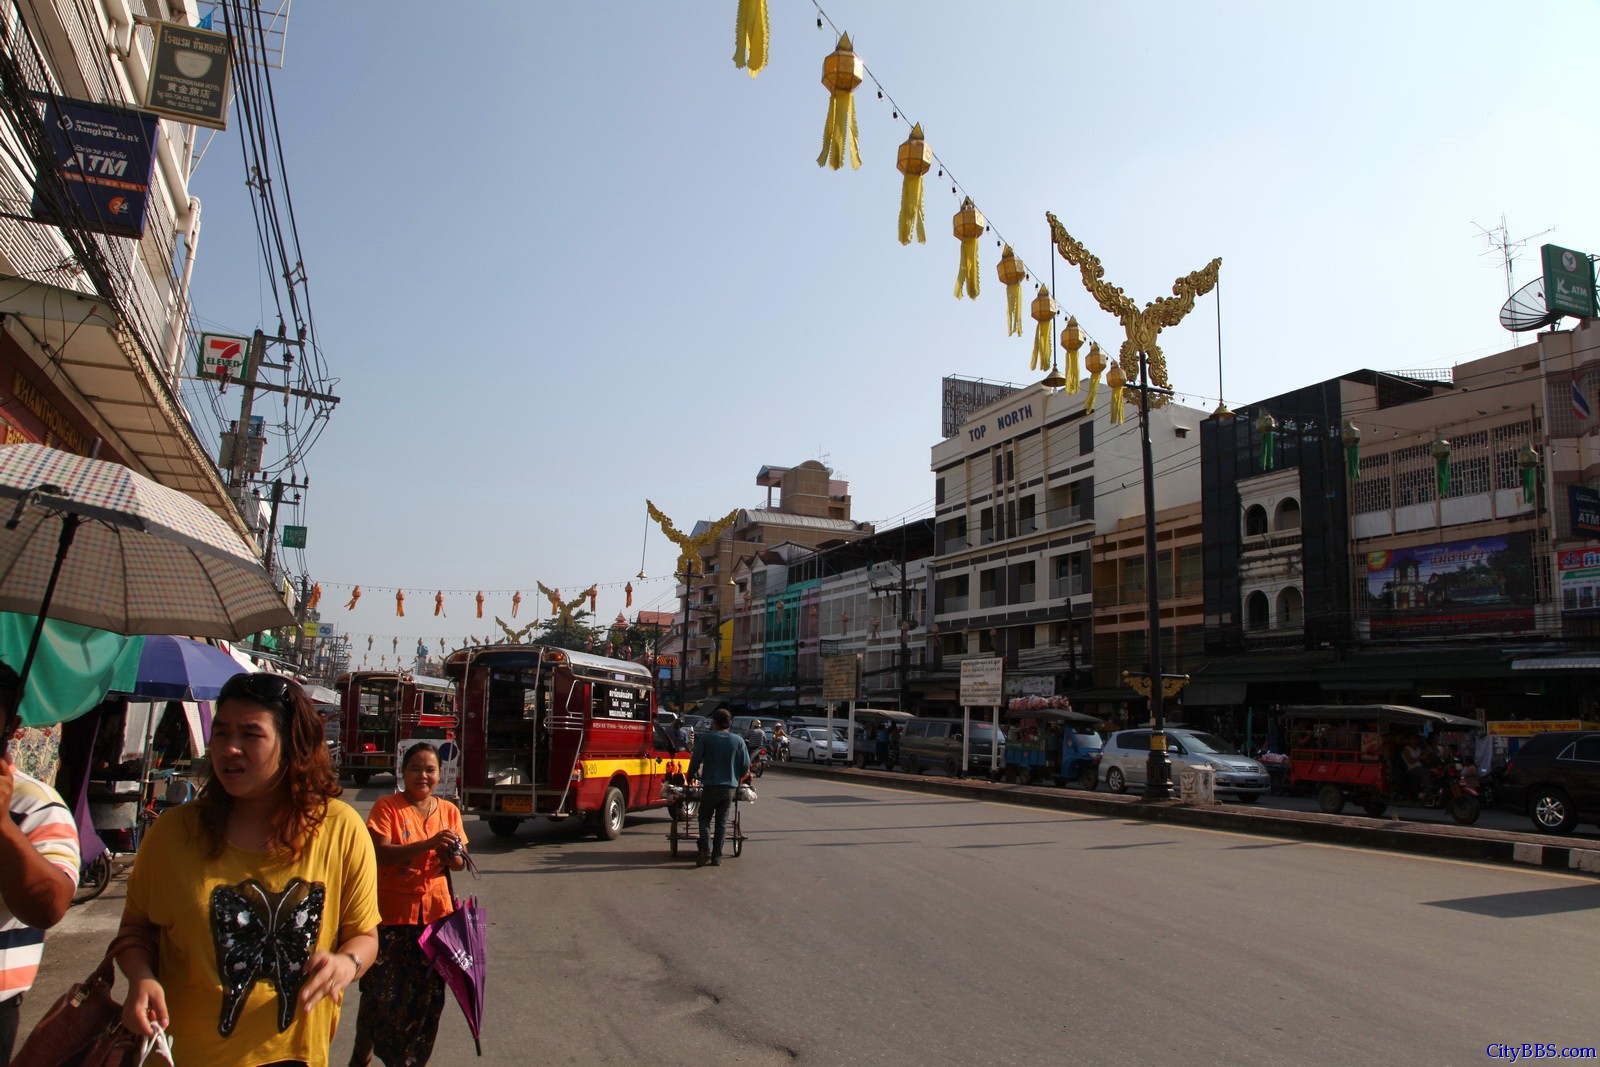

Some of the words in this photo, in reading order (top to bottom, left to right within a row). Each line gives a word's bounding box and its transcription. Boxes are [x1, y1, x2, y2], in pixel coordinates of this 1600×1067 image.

[164, 30, 191, 48] โรงแรม
[204, 83, 221, 92] HOTEL
[62, 151, 128, 177] ATM
[1557, 277, 1570, 294] K
[1571, 285, 1588, 297] ATM
[210, 339, 241, 359] 7
[968, 424, 987, 442] TOP
[997, 404, 1033, 430] NORTH
[1578, 512, 1599, 525] ATM
